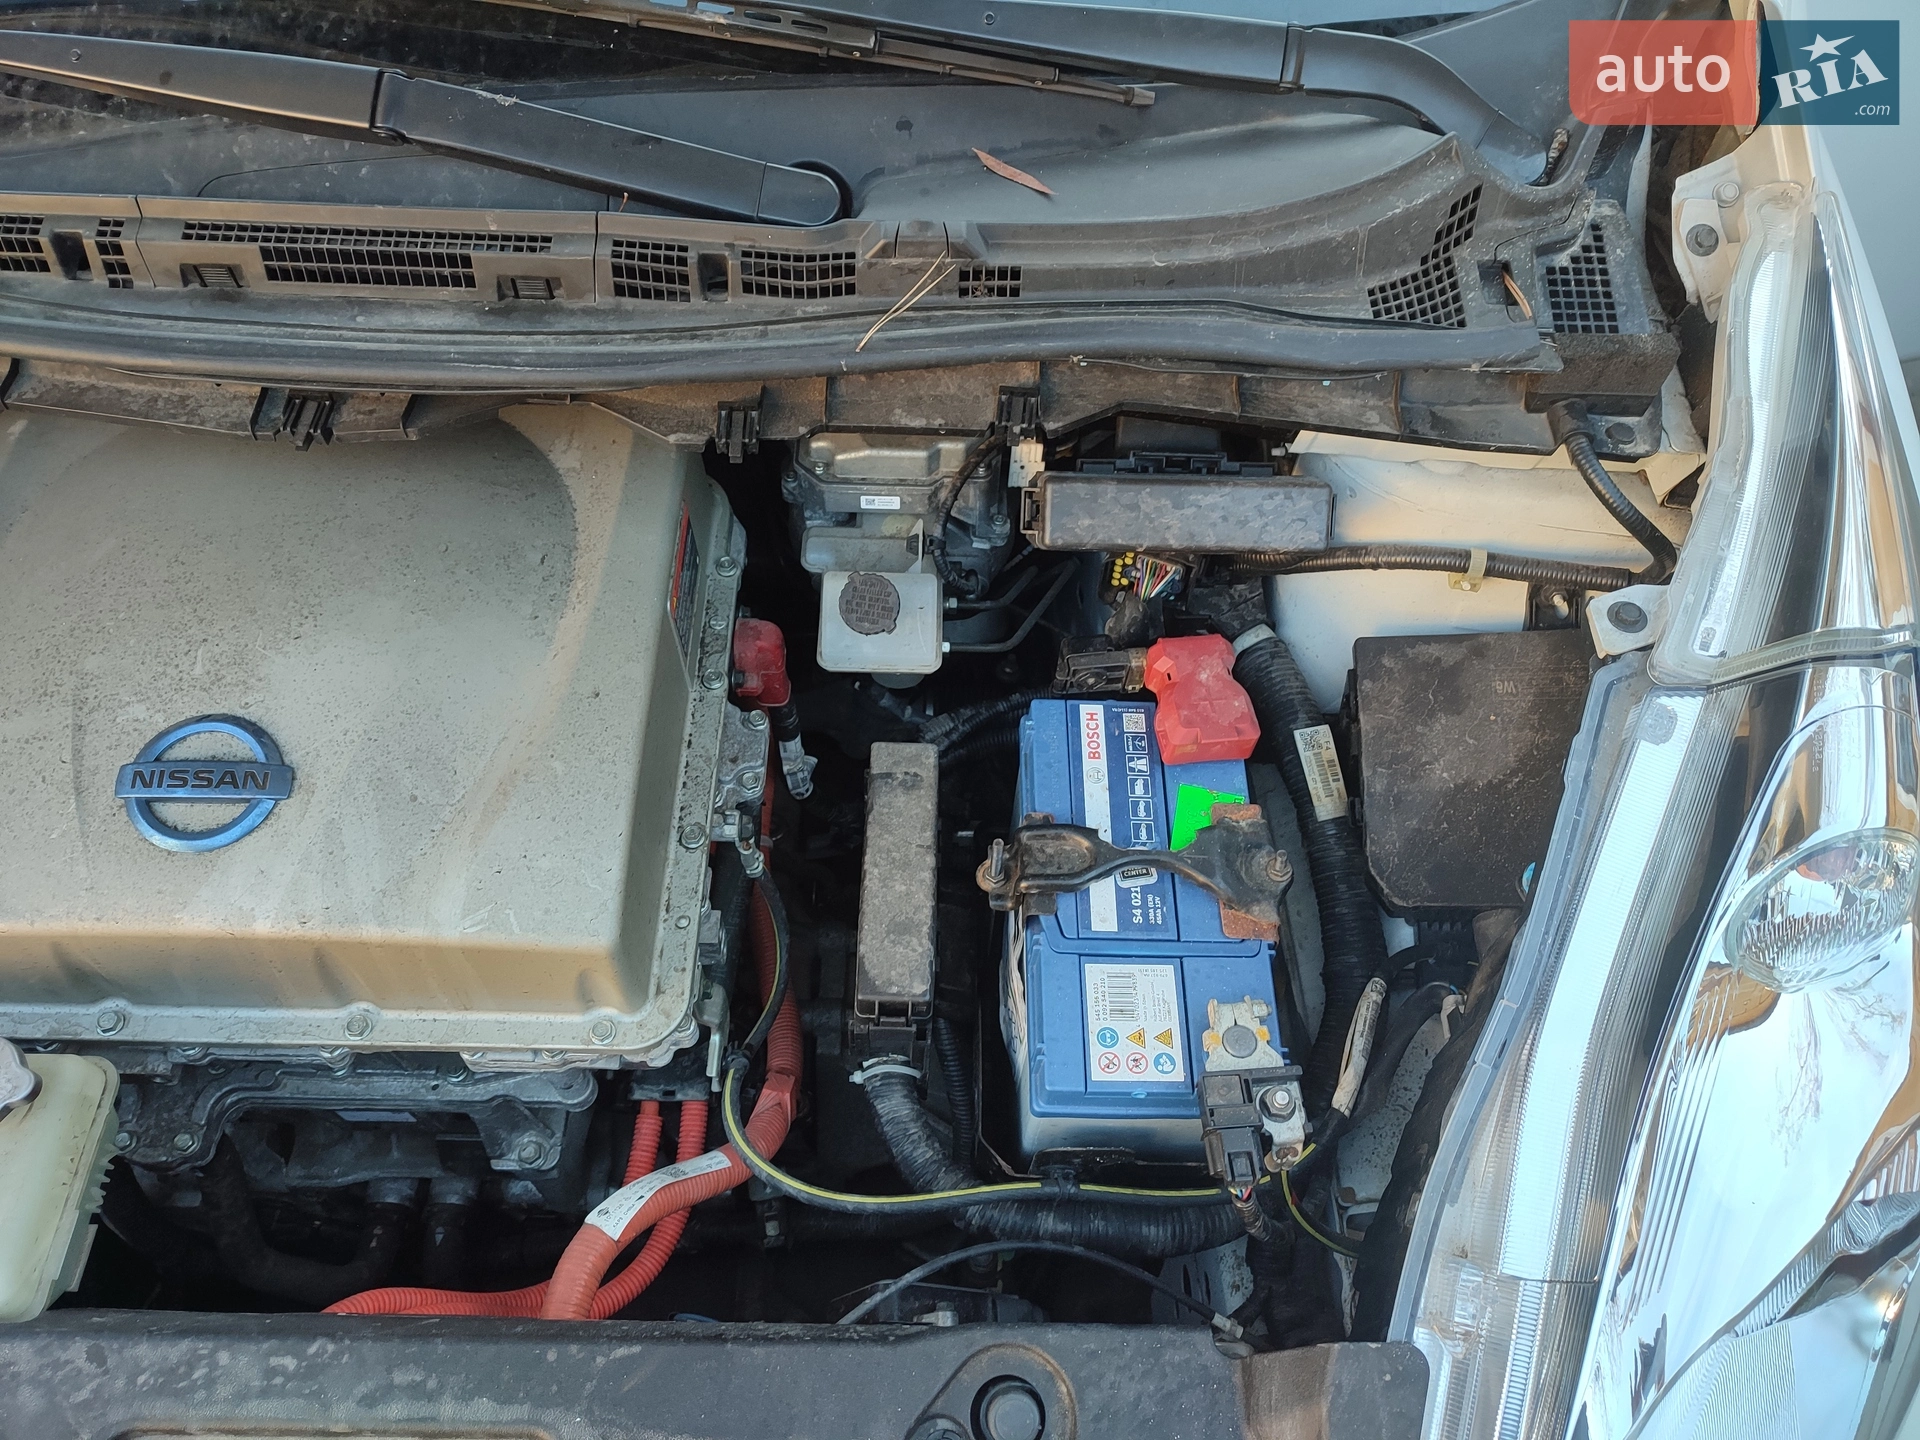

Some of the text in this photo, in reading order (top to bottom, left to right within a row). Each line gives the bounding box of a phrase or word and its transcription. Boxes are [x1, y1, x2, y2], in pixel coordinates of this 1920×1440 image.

[1085, 712, 1102, 761] BOSCH
[131, 768, 271, 791] NISSAN
[1123, 868, 1148, 877] CENTER
[1130, 886, 1143, 924] S4 021
